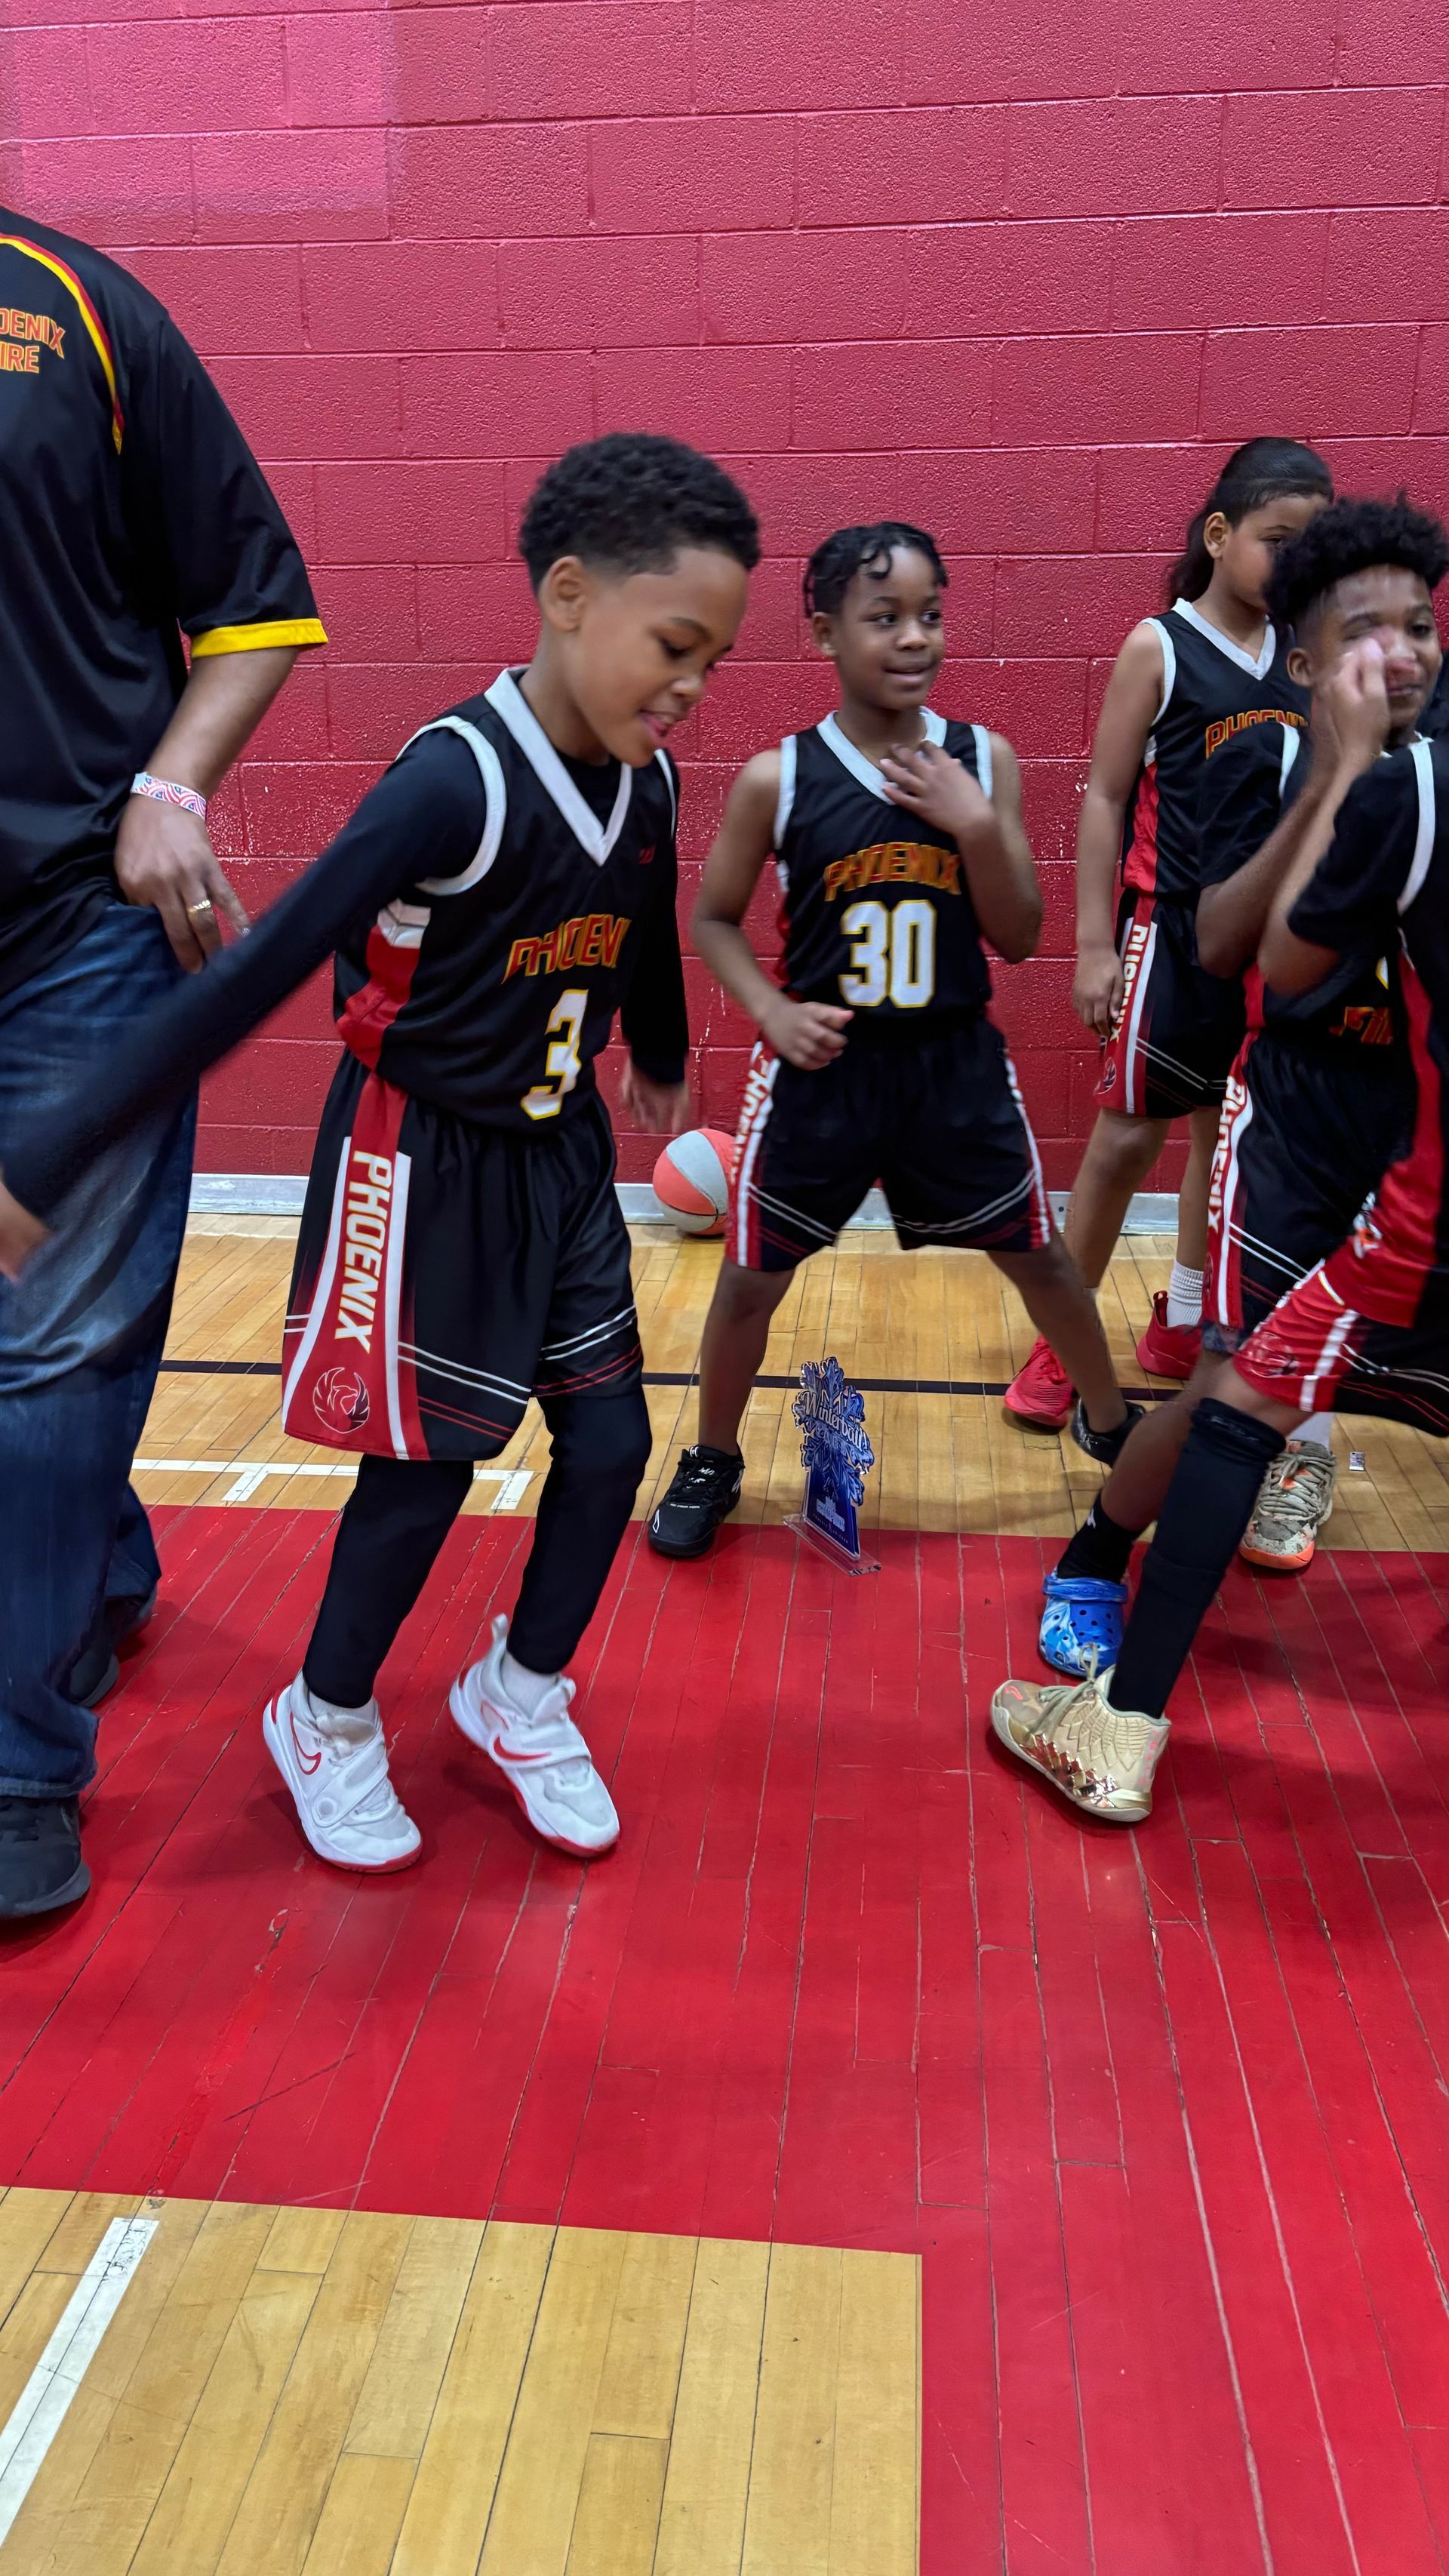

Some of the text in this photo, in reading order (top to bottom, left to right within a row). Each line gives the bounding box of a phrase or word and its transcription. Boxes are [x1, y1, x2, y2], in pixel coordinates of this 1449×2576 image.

[823, 842, 961, 902] PHOENIX
[838, 899, 937, 1008] 30
[521, 989, 589, 1121] 3
[334, 1150, 392, 1355] PHOENIX
